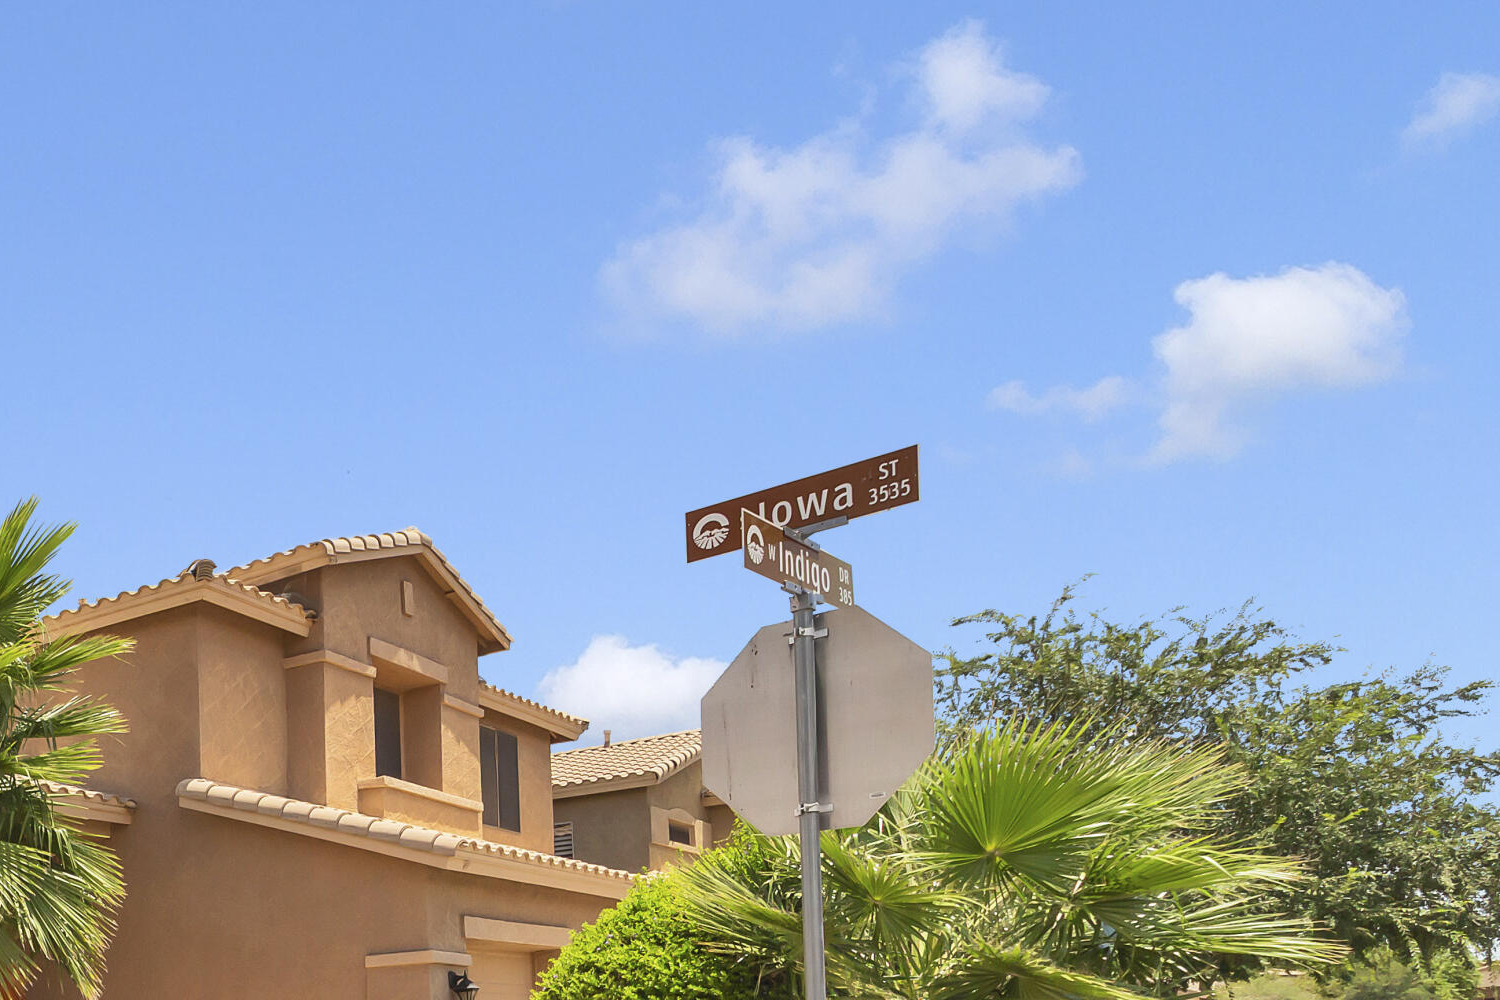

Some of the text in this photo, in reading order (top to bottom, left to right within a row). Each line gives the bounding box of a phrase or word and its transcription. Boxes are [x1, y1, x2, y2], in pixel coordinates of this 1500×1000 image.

[878, 459, 899, 480] ST
[868, 478, 911, 506] 3535
[767, 541, 850, 595] W Indigo DR
[838, 586, 853, 607] 385
